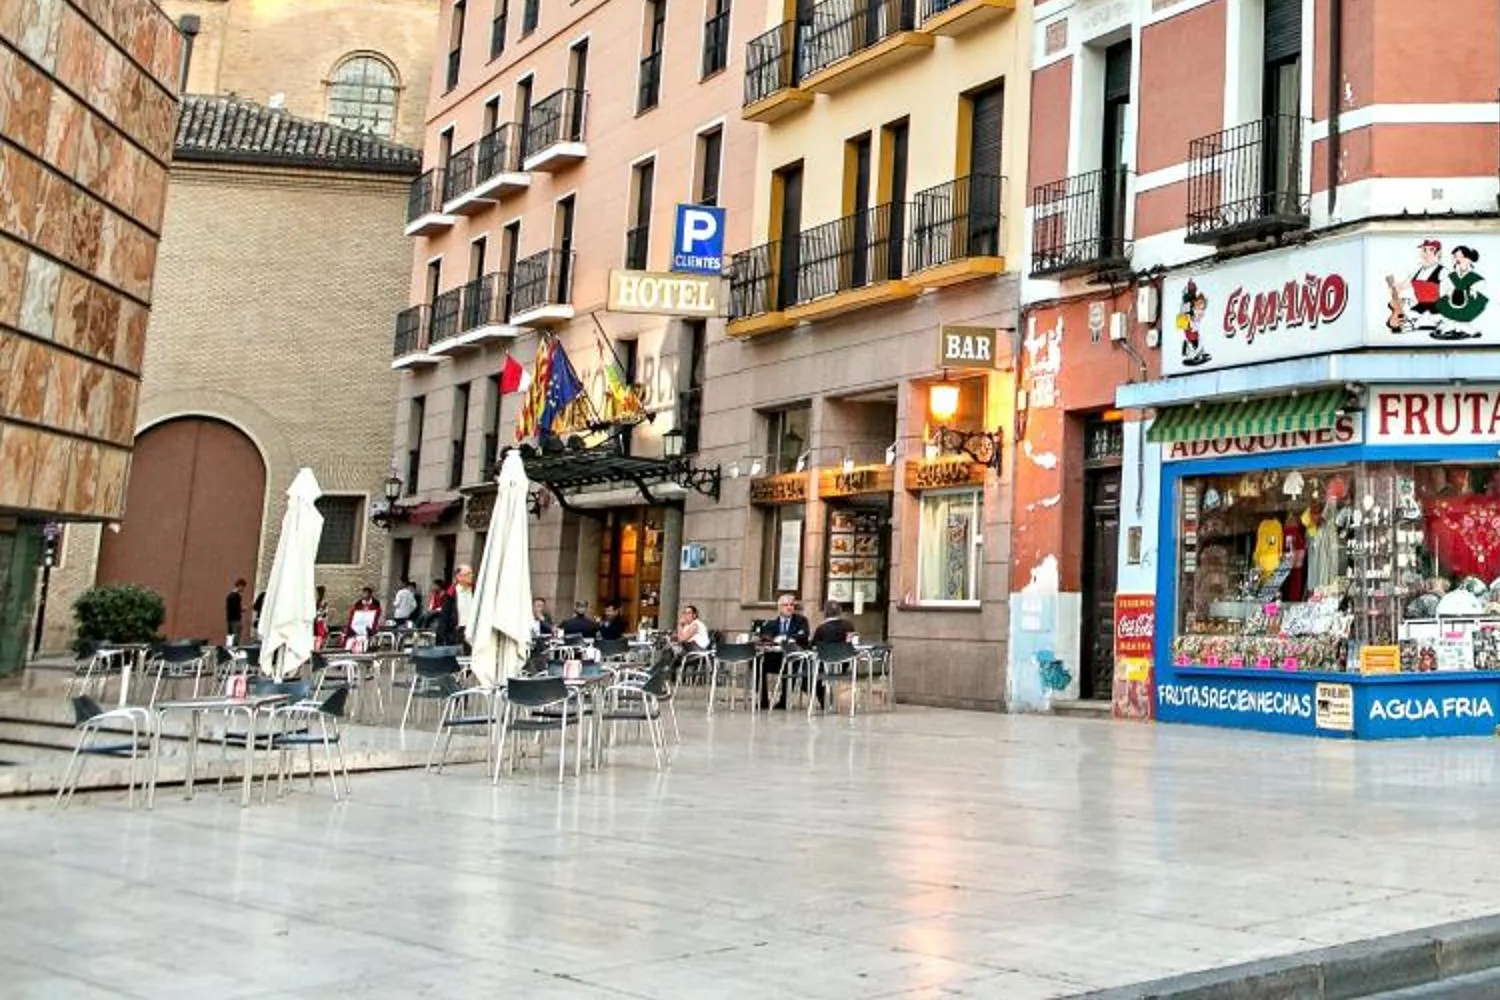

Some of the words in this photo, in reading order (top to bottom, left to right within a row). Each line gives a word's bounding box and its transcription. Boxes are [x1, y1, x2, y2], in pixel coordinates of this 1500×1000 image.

[683, 209, 717, 253] P
[675, 253, 721, 269] CLIENTES
[616, 275, 717, 311] HOTEL
[945, 334, 991, 361] BAR
[1369, 698, 1440, 720] AGUA
[1441, 697, 1494, 718] FRIA
